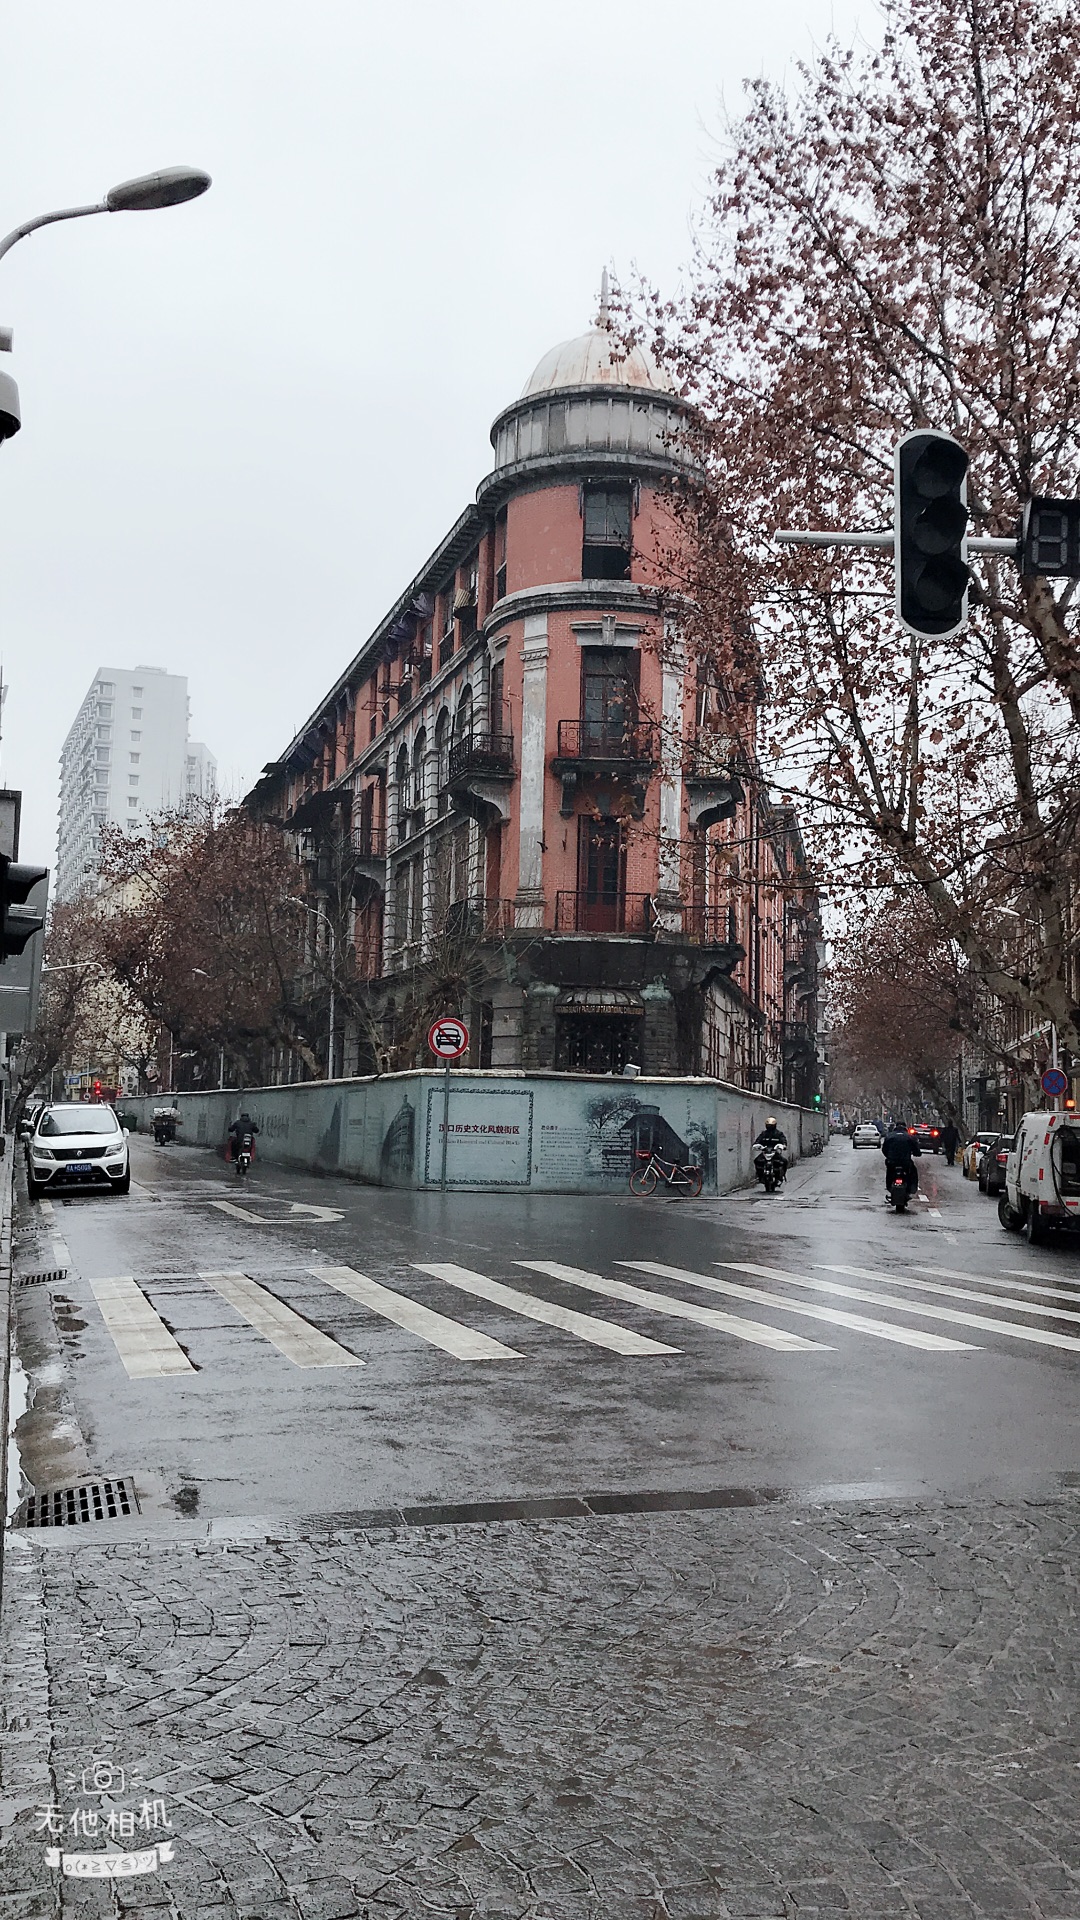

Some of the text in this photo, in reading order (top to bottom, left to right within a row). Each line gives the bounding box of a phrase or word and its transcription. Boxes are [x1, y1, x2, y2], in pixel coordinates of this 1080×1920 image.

[438, 1123, 520, 1135] 汉口历史文化风貌街区
